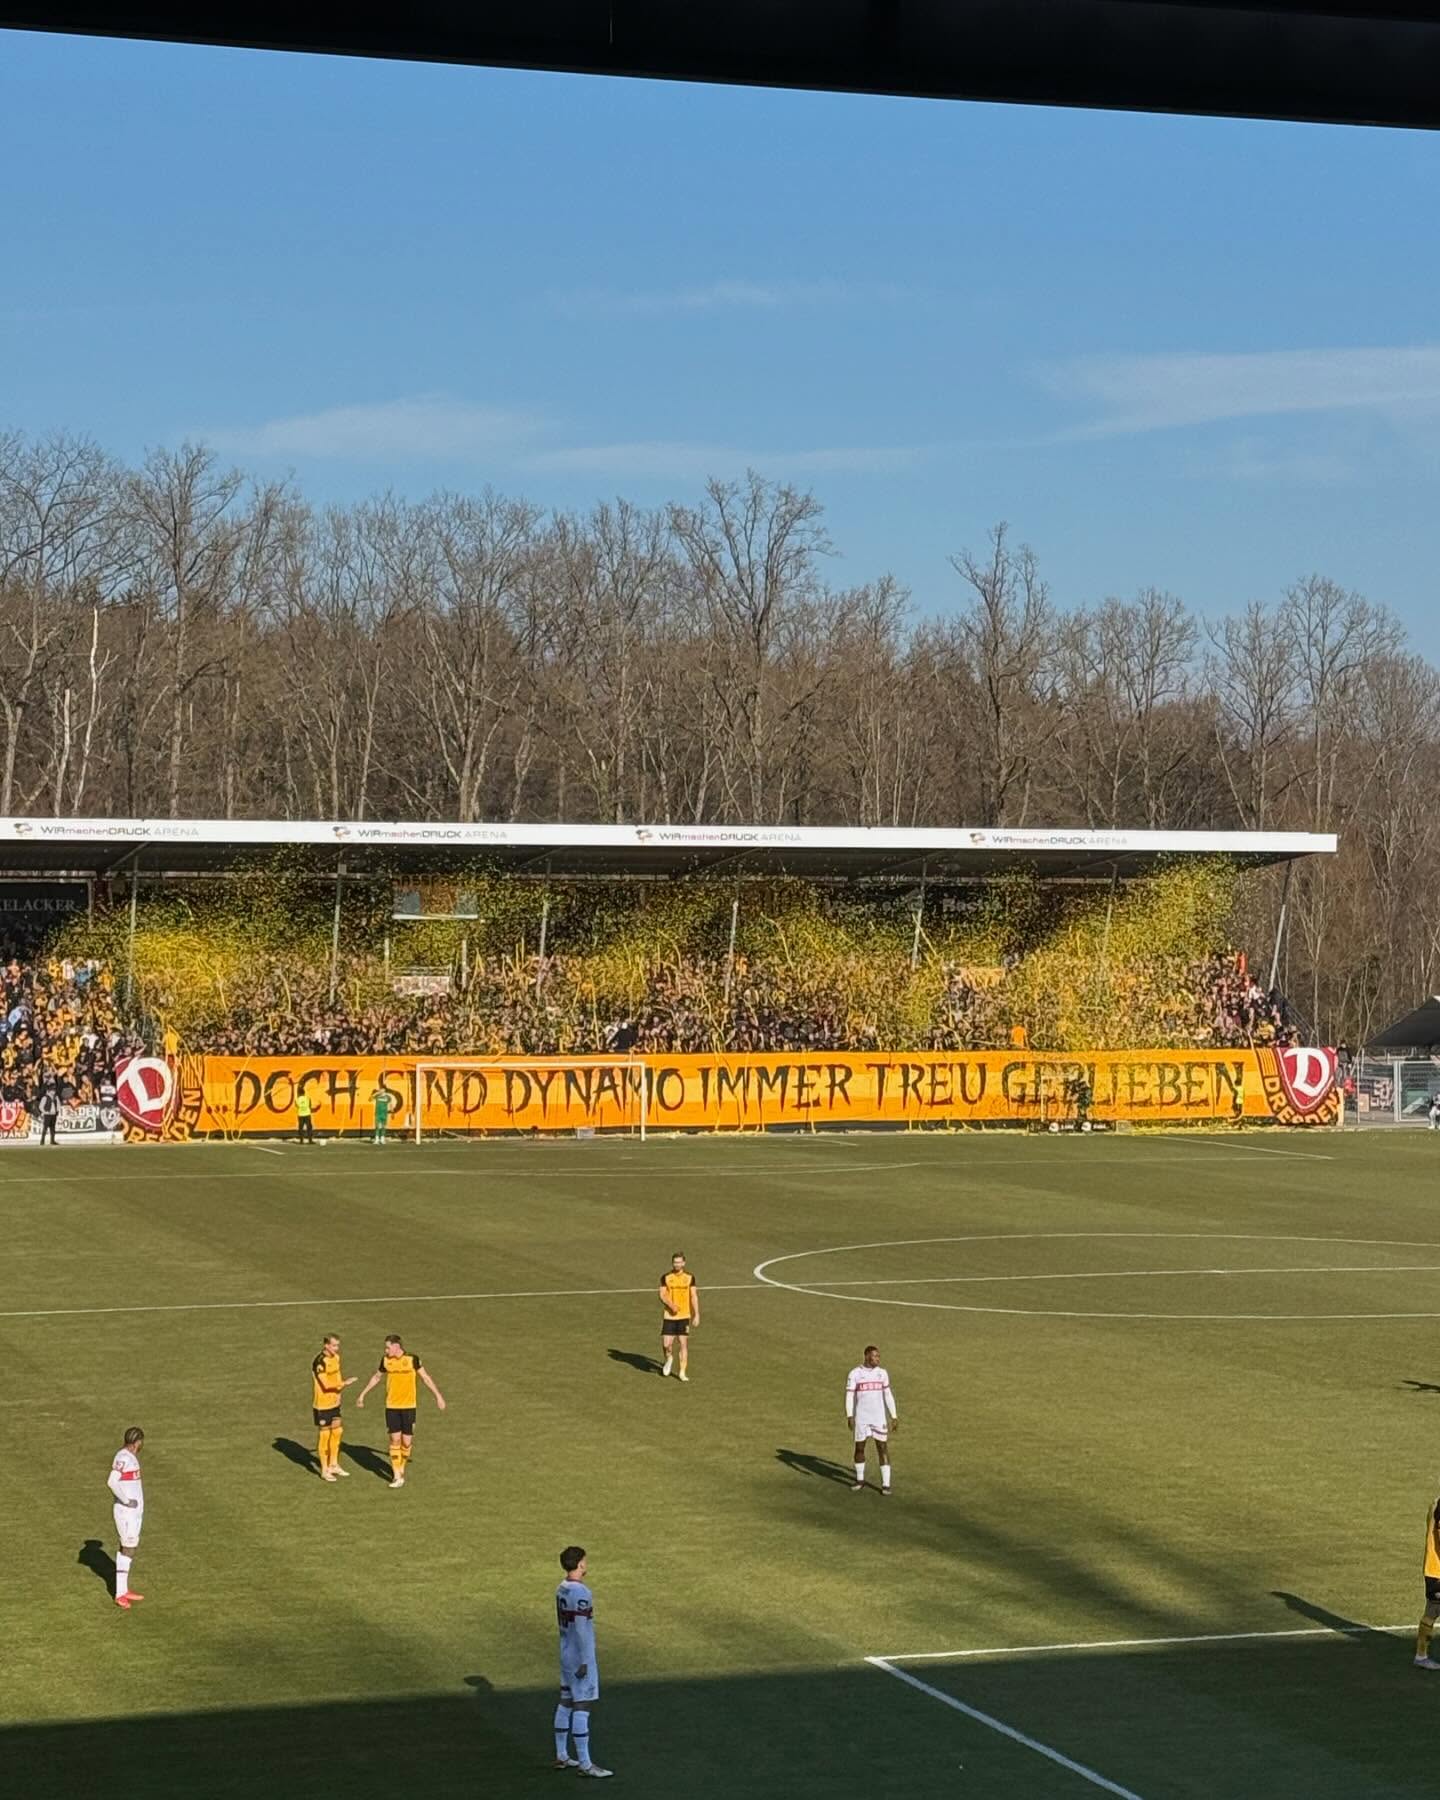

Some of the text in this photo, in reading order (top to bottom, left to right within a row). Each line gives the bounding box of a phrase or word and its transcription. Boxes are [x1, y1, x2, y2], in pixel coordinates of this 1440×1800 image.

[154, 827, 200, 837] ARENA
[464, 830, 508, 840] ARENA
[0, 899, 80, 912] ELACKER
[232, 1069, 363, 1120] DOCH
[369, 1069, 488, 1118] SIND
[501, 1067, 686, 1120] DYNAMO
[697, 1064, 853, 1114] IMMER
[865, 1062, 988, 1112] TREU
